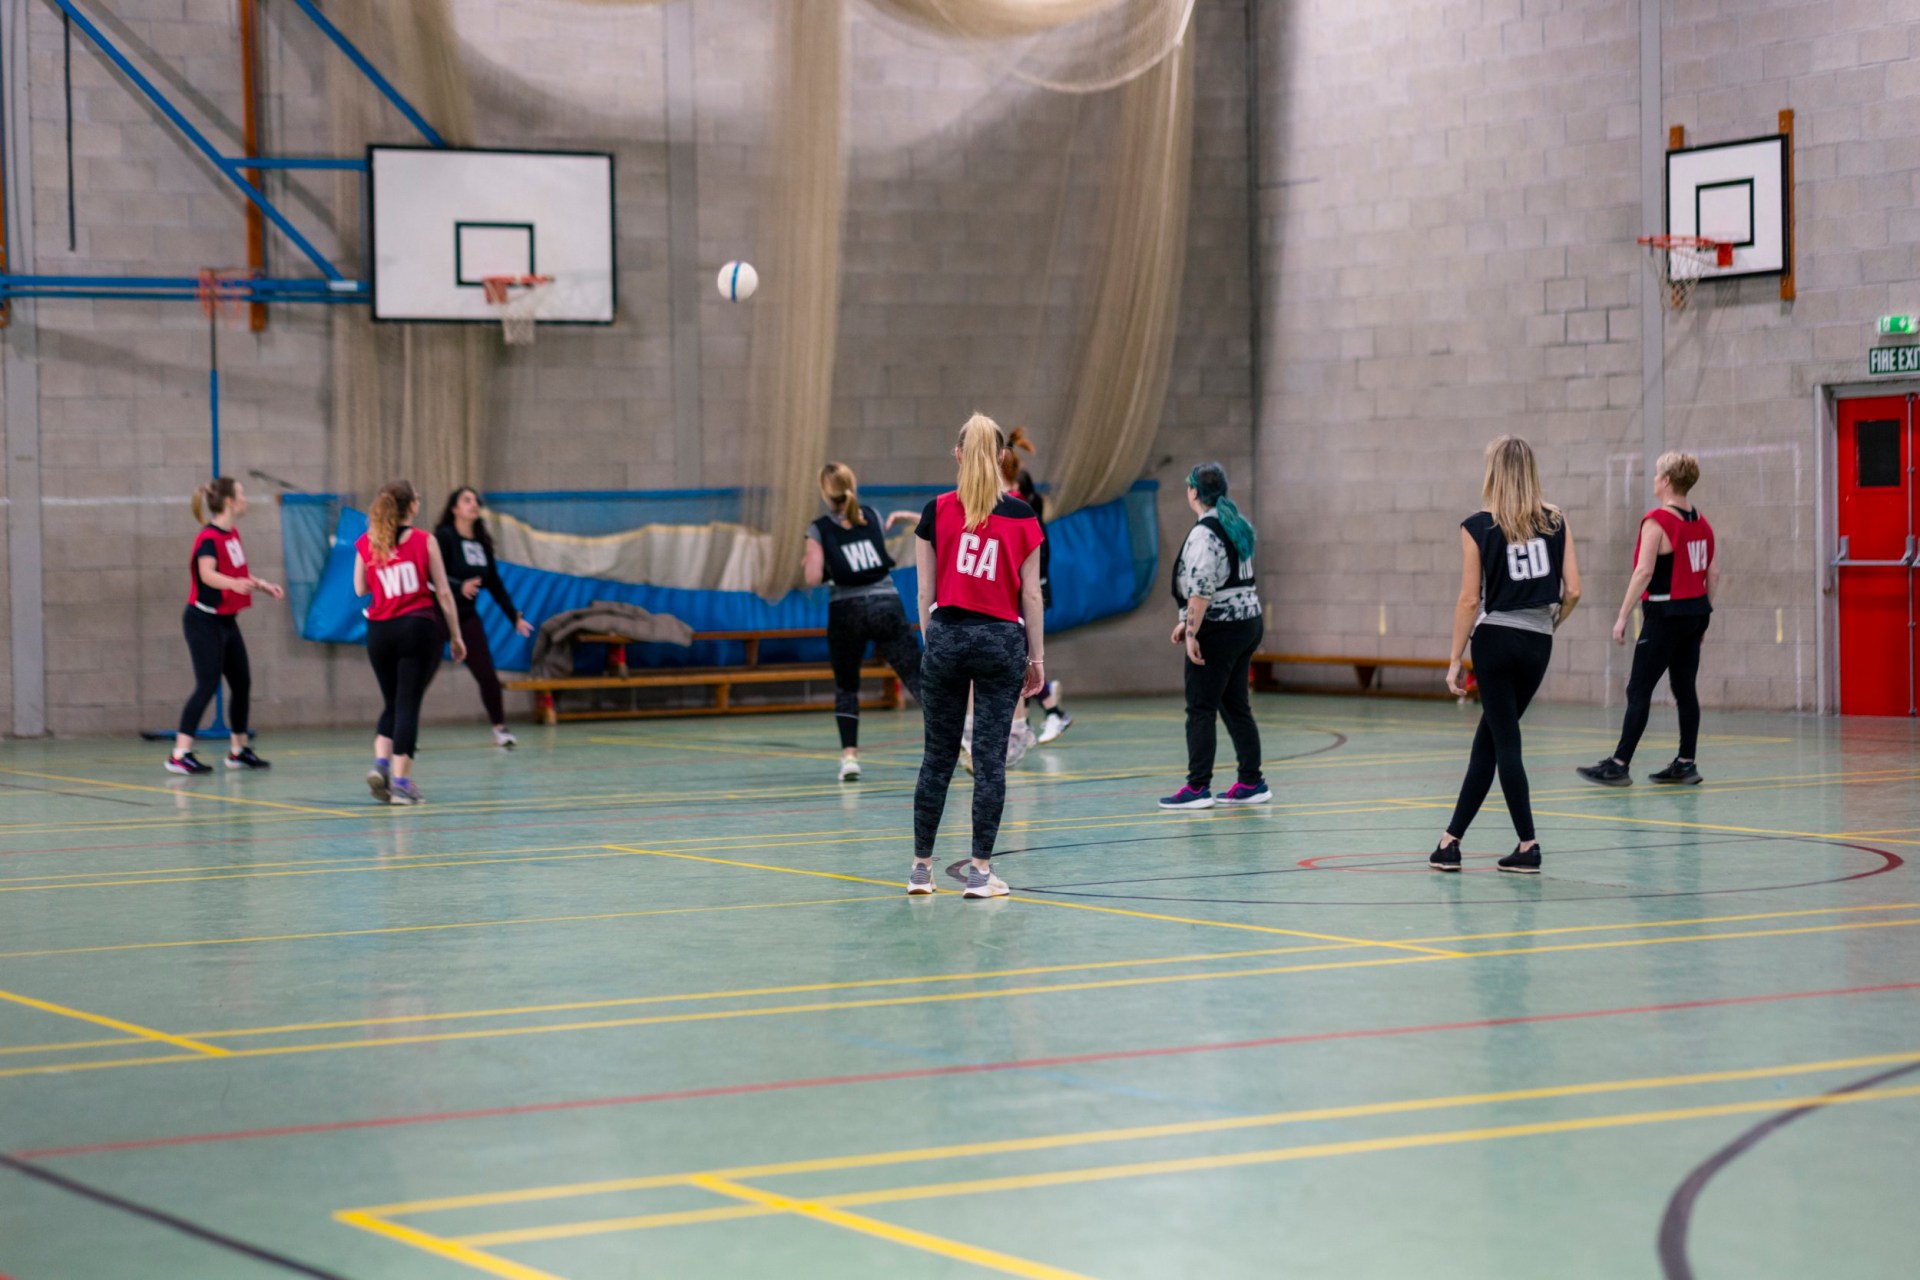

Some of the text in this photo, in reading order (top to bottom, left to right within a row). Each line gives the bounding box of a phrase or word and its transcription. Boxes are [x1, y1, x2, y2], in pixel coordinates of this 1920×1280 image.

[1871, 347, 1920, 372] FIRE EXI
[841, 540, 881, 572] WA
[956, 532, 999, 581] GA
[1507, 538, 1551, 581] GD
[1687, 539, 1707, 573] WA
[376, 561, 420, 599] WD
